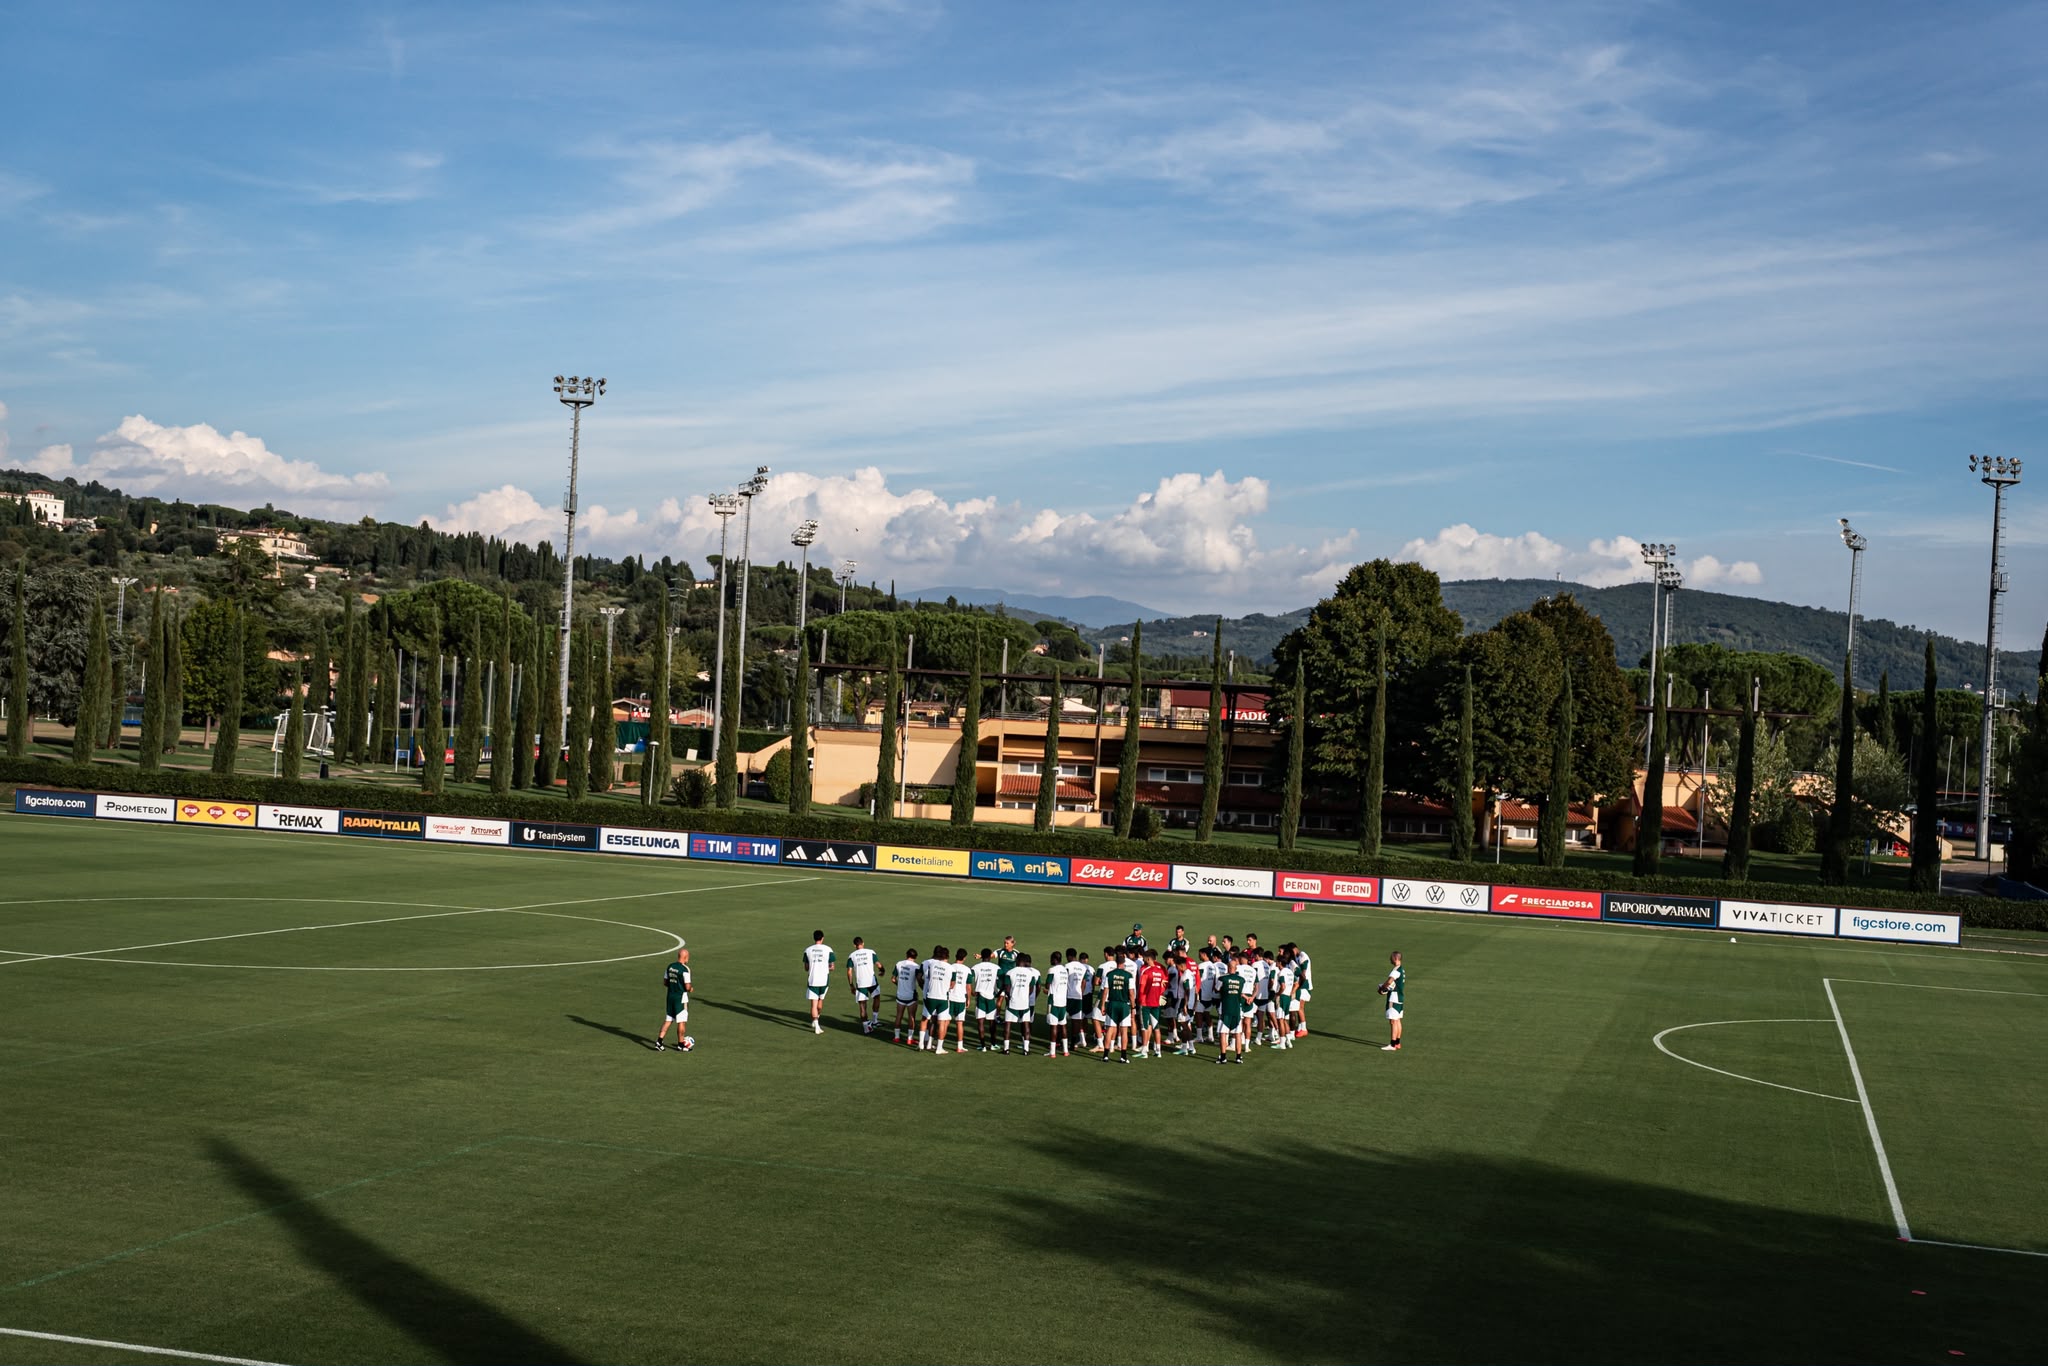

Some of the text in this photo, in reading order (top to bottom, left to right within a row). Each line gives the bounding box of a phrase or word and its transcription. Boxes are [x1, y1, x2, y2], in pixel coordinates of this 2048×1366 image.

[25, 795, 86, 808] figcstore.com
[106, 801, 167, 815] PROMETEON
[538, 831, 586, 842] TeamSystem
[607, 834, 680, 849] ESSELUNGA
[708, 840, 777, 857] TIM TIM
[977, 857, 1044, 875] eni eni
[1076, 863, 1164, 882] Lete Lete
[1285, 880, 1370, 896] PERONI PERONI
[1521, 897, 1594, 909] FRECCIAROSSA
[1610, 901, 1711, 918] EMPORIO ARMANI
[1732, 909, 1824, 926] VIVATICKET
[1853, 916, 1946, 933] figcstore.com
